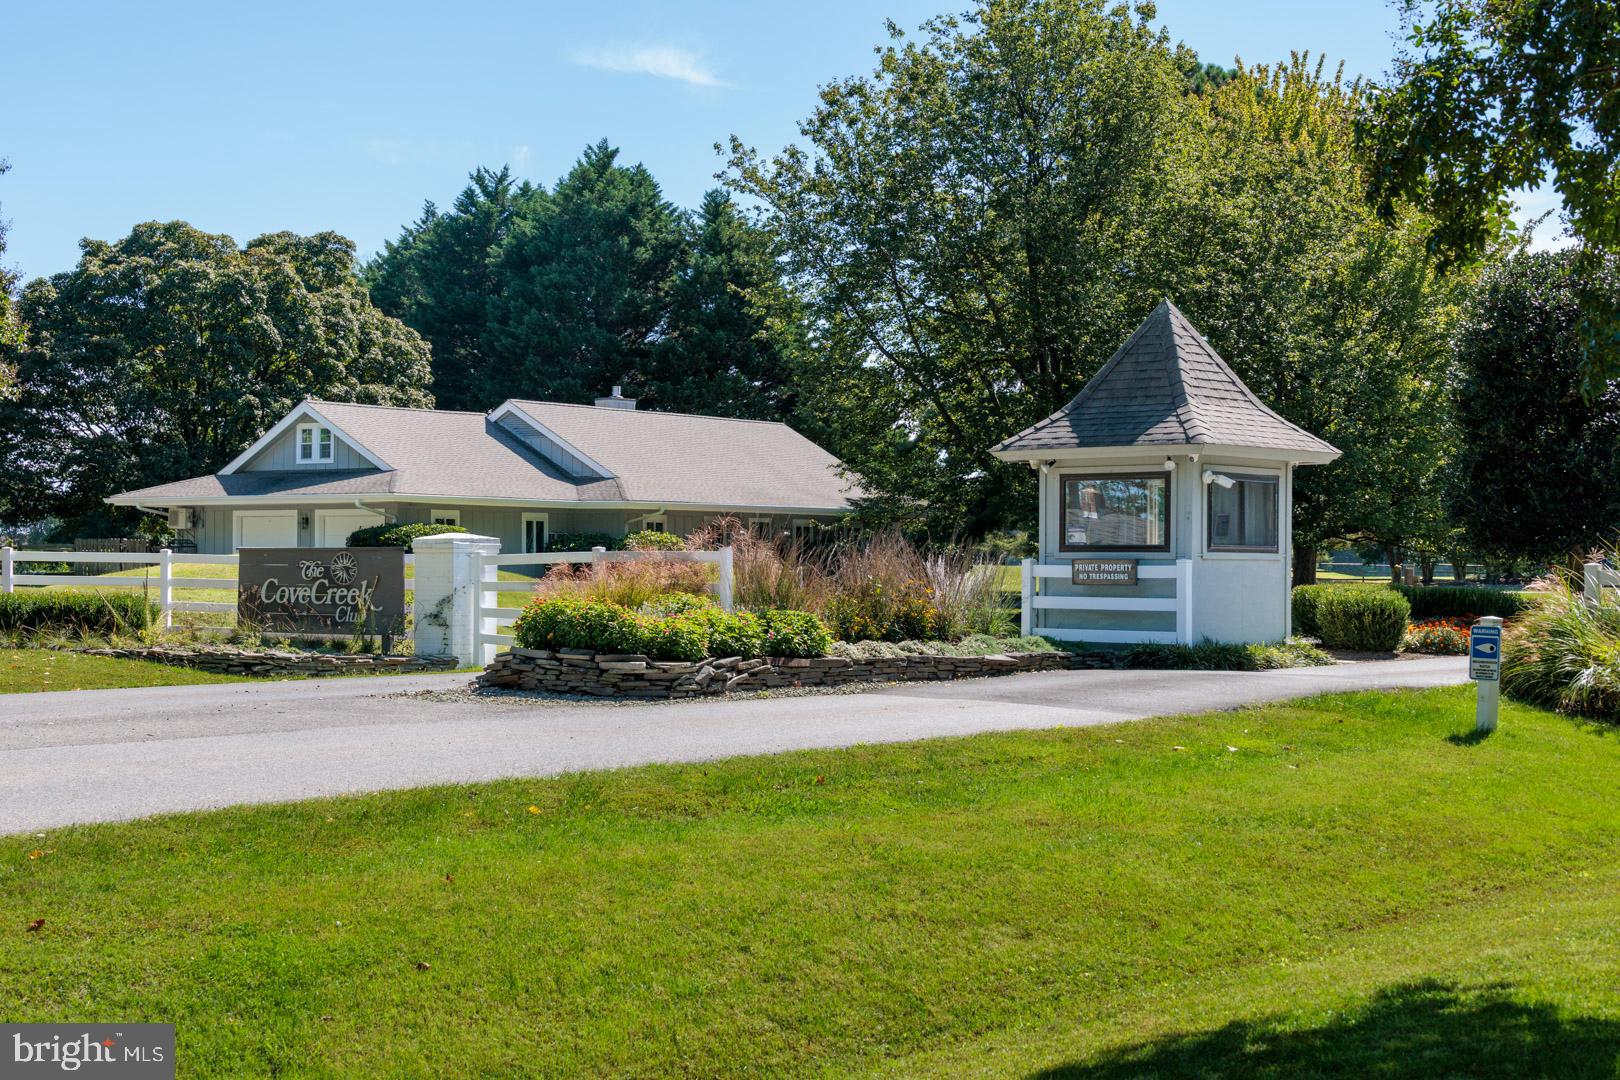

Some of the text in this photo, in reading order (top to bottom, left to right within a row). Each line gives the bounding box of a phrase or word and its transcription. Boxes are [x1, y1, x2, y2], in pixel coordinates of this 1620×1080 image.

[300, 560, 325, 581] The
[1074, 563, 1132, 571] PRIVATE PROPERTY
[335, 605, 362, 623] Clu
